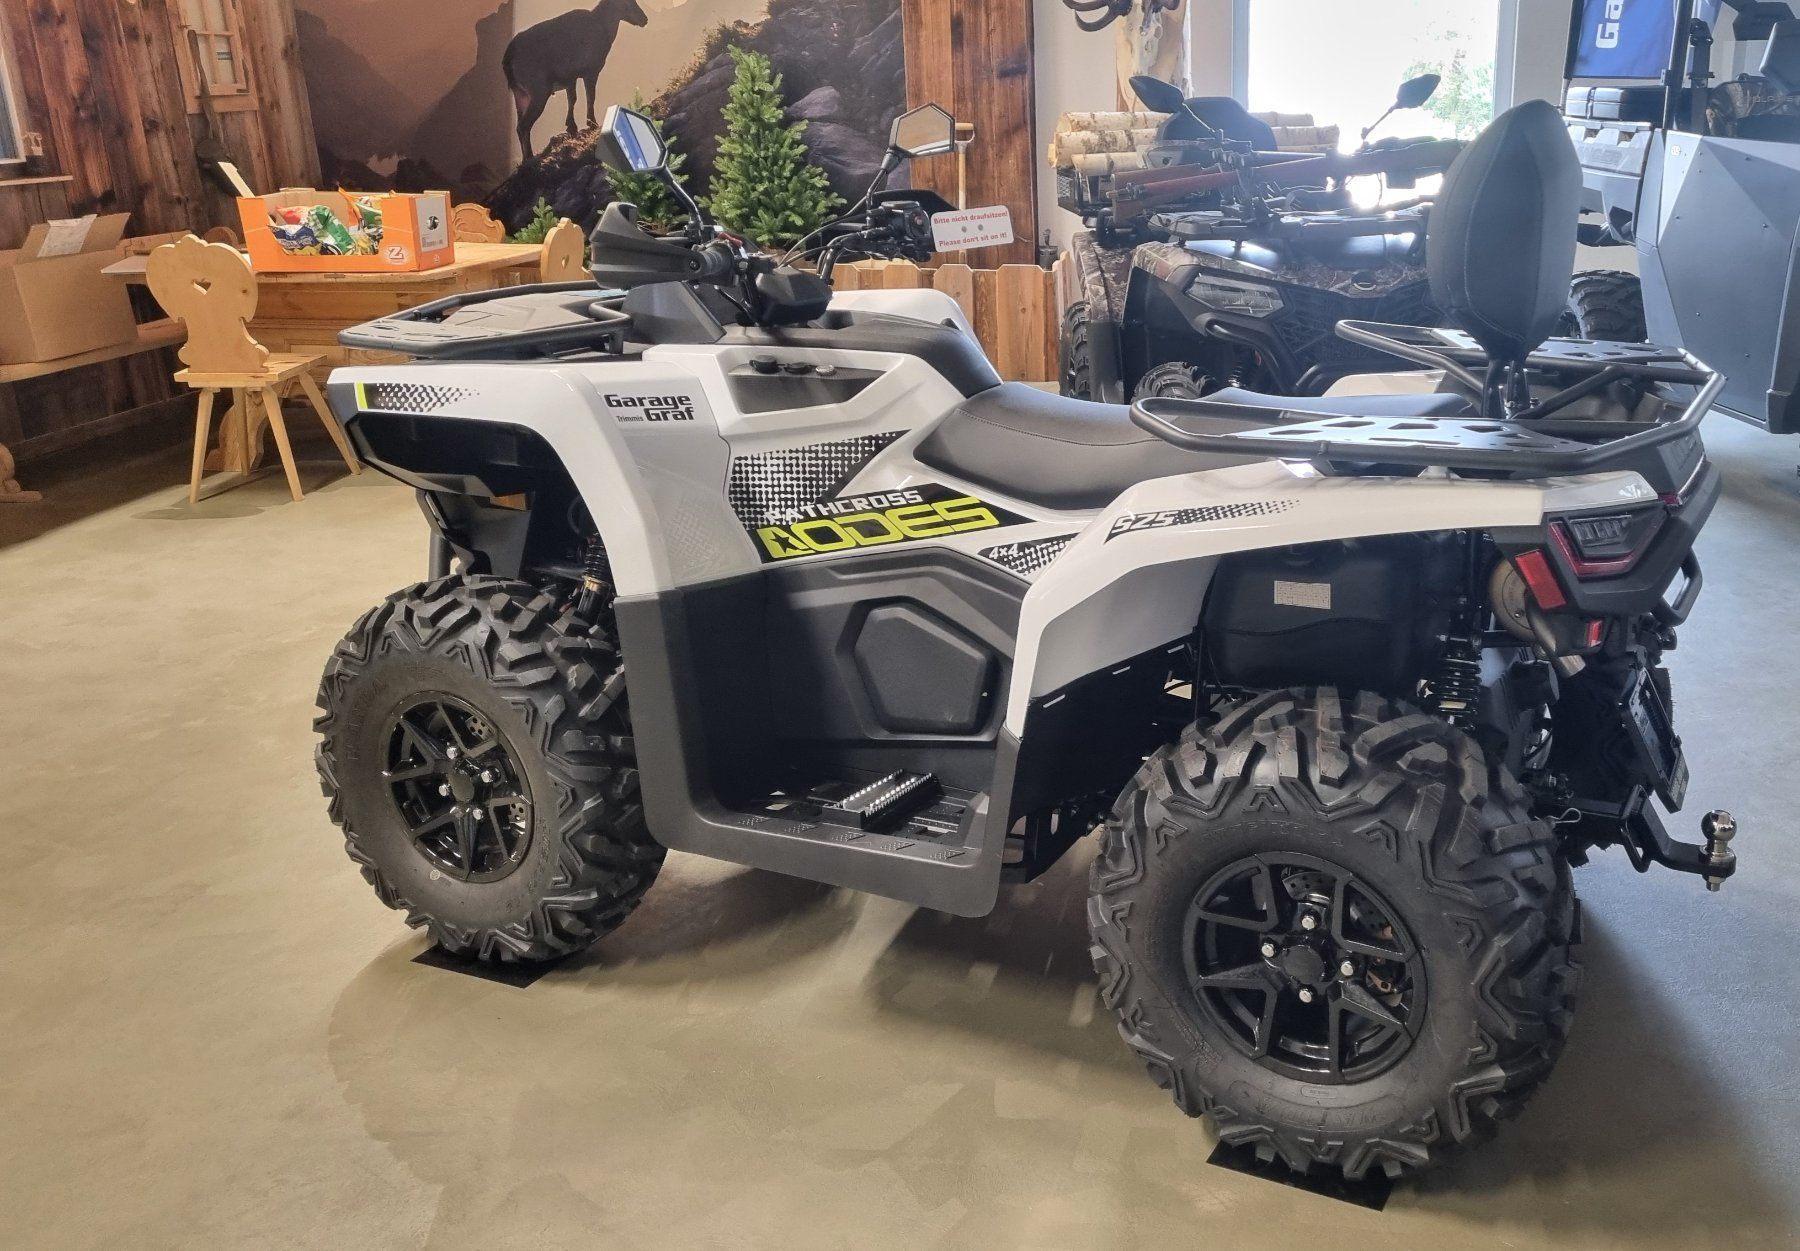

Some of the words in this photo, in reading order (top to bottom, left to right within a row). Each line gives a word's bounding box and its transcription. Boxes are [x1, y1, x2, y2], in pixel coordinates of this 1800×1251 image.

[969, 211, 1008, 221] draufsitzen!
[962, 236, 979, 244] don't
[603, 394, 692, 410] Garage
[616, 415, 644, 423] Trimmis
[643, 406, 695, 422] Graf
[762, 489, 924, 525] PATHCROSS
